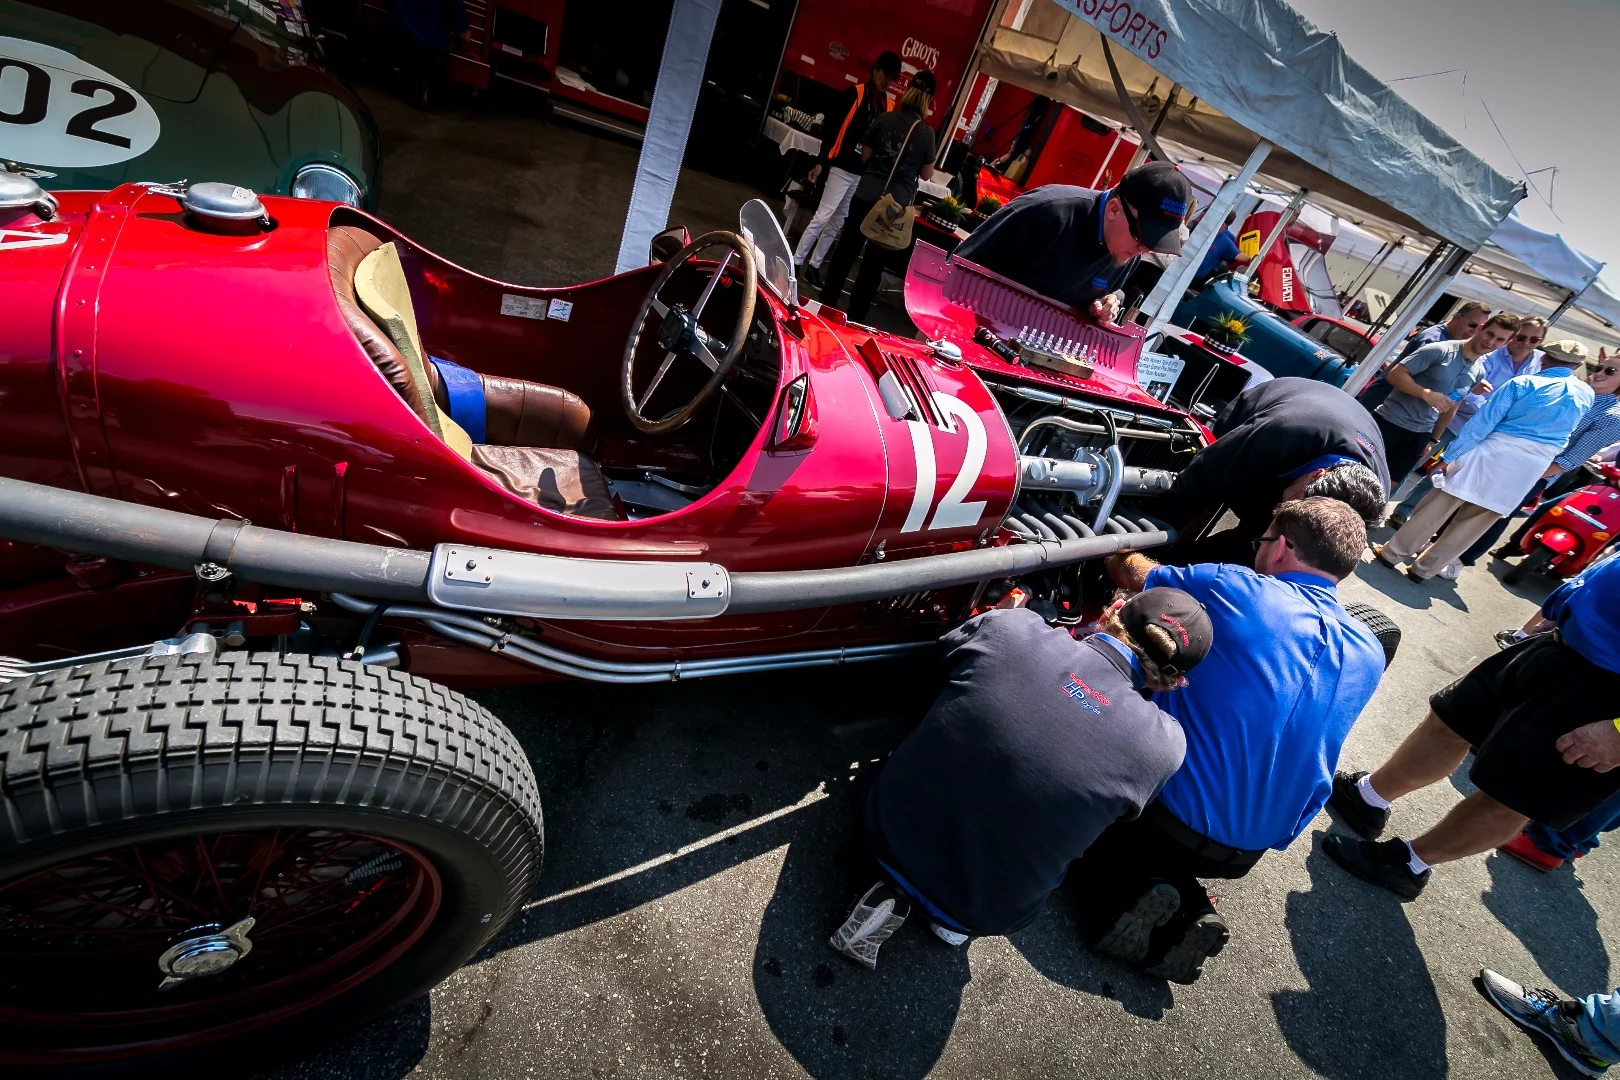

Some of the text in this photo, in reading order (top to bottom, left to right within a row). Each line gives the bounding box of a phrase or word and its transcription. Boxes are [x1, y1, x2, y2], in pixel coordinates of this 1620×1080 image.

[1065, 0, 1168, 59] SPORTS
[901, 37, 940, 70] GRIOT'S
[900, 387, 988, 534] 12
[1063, 681, 1085, 699] HP
